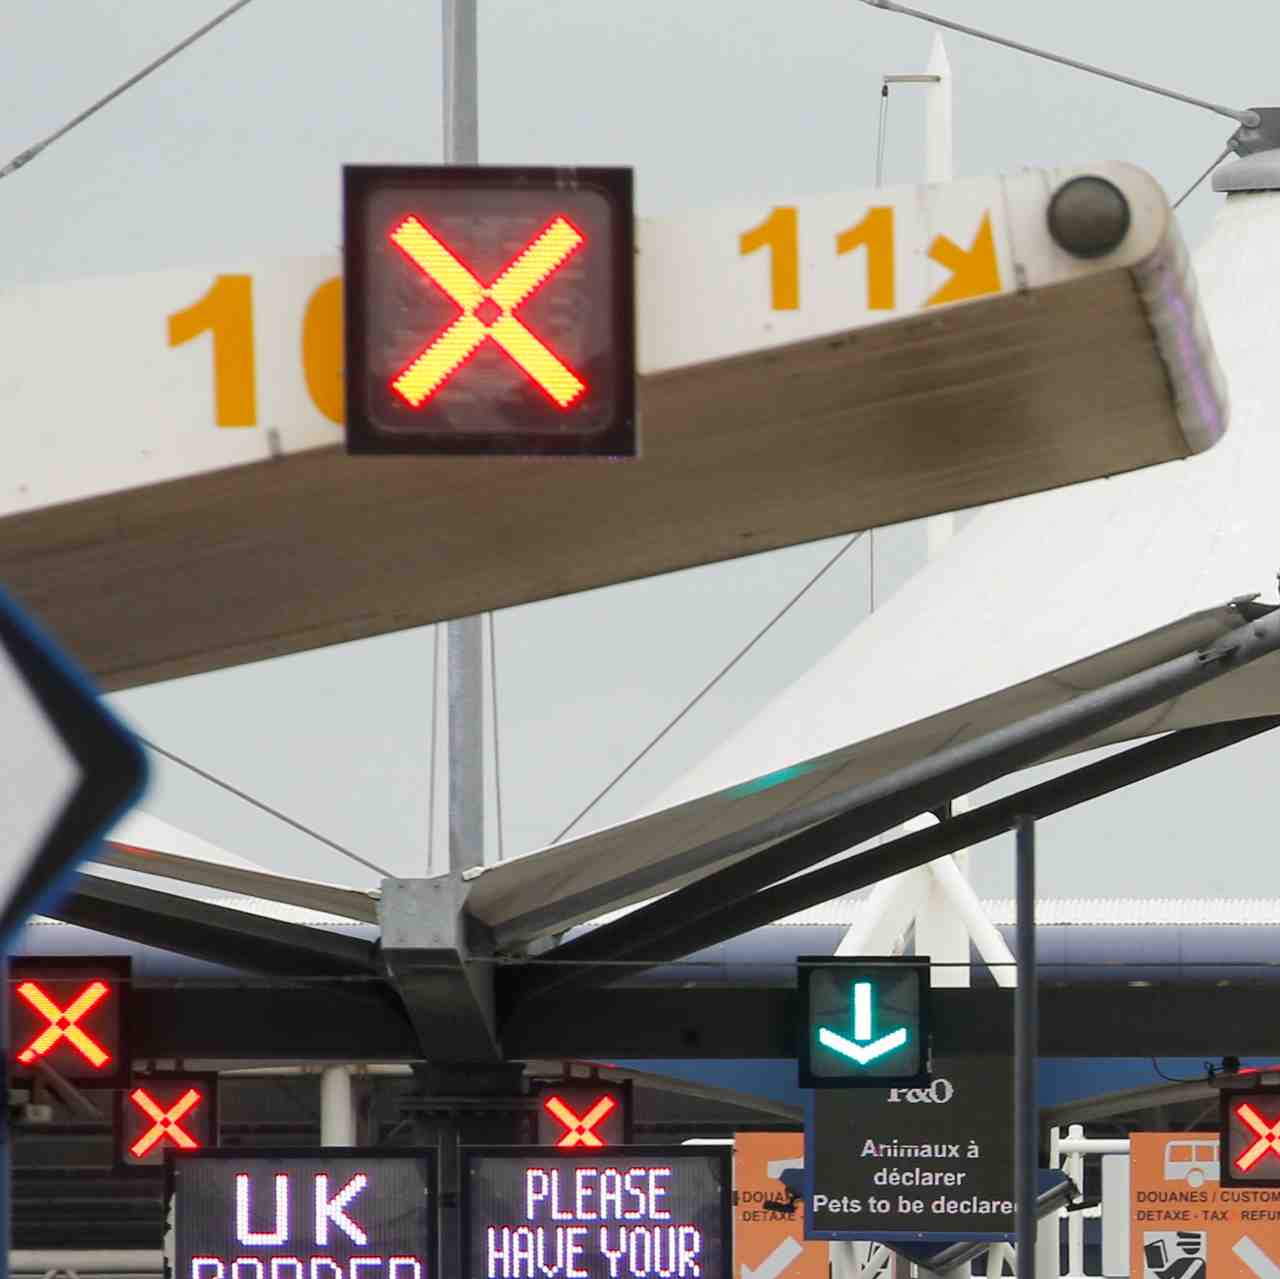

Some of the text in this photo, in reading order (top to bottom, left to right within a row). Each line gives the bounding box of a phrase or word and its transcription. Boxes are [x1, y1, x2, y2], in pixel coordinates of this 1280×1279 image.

[739, 206, 897, 312] 11
[860, 1139, 980, 1158] Animaux à
[873, 1168, 967, 1187] déclarer
[525, 1167, 672, 1220] PLEASE
[1136, 1191, 1208, 1203] DOUANES
[235, 1172, 369, 1246] UK
[812, 1195, 862, 1213] Pets
[868, 1197, 893, 1213] to
[899, 1195, 924, 1213] be
[1136, 1211, 1190, 1221] DETAXE
[1203, 1211, 1228, 1221] TAX
[486, 1226, 702, 1279] HAVE YOUR
